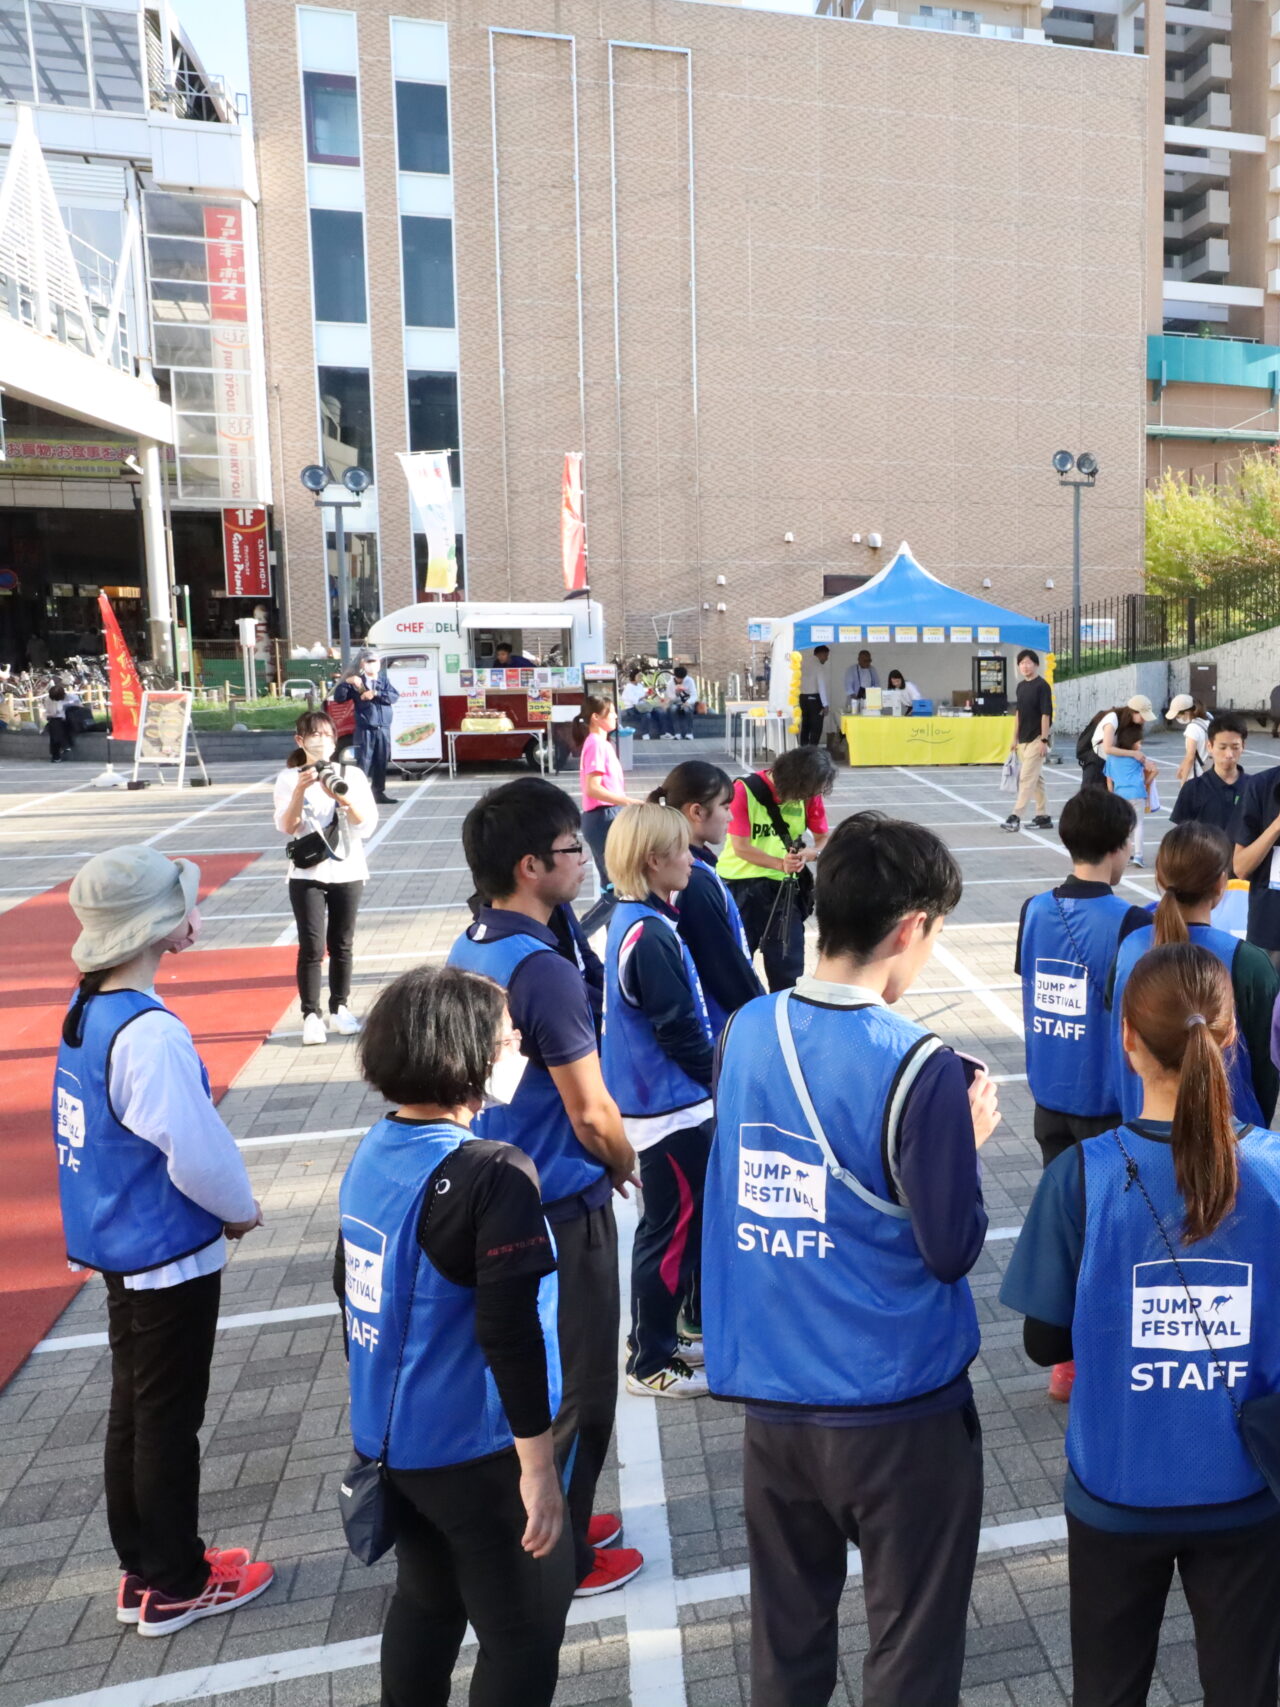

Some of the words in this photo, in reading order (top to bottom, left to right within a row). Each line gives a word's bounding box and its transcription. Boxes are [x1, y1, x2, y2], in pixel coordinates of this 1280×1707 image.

[235, 509, 254, 526] 1F
[396, 622, 424, 633] CHEF
[911, 723, 951, 737] yellow
[1037, 980, 1065, 992] JUMP
[1036, 993, 1082, 1009] FESTIVAL
[1033, 1016, 1086, 1040] STAFF
[744, 1160, 791, 1180] JUMP
[744, 1182, 819, 1213] FESTIVAL
[737, 1222, 835, 1258] STAFF
[1142, 1298, 1202, 1314] JUMP
[1141, 1320, 1241, 1337] FESTIVAL
[1130, 1361, 1248, 1391] STAFF
